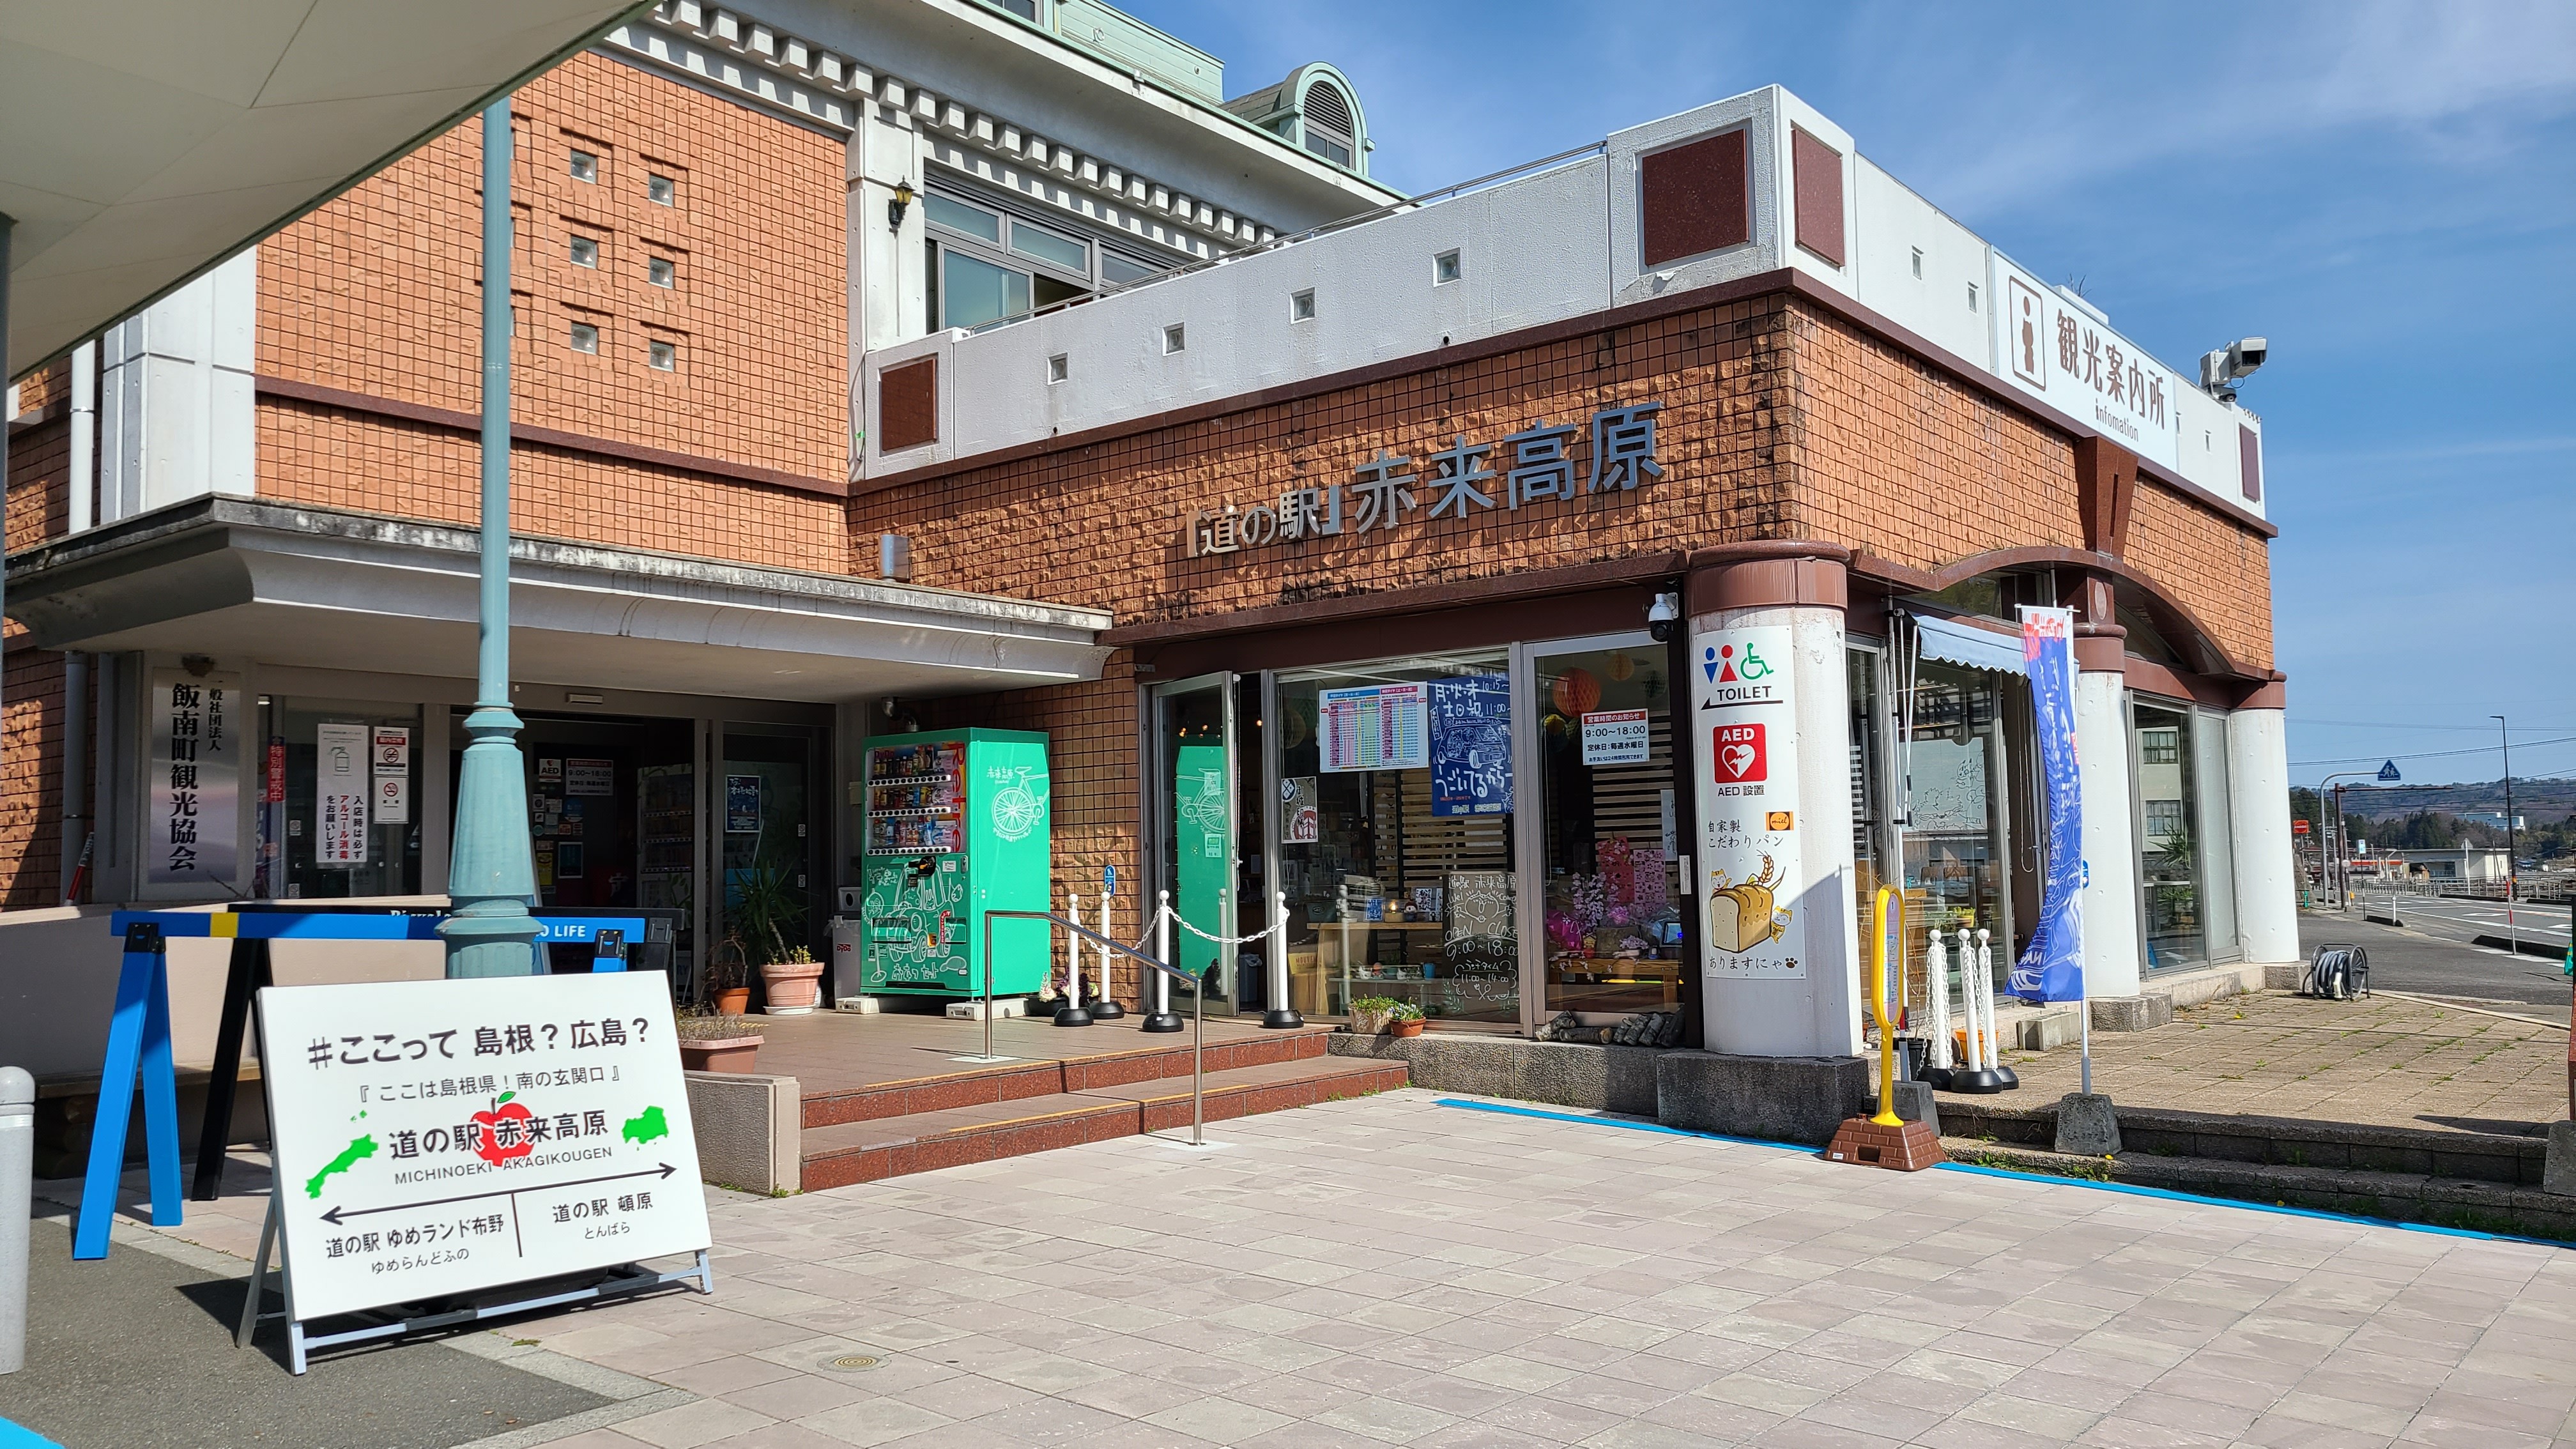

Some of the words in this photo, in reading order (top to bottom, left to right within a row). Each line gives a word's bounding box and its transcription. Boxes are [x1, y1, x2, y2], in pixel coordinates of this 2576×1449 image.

[2057, 309, 2165, 430] 観光案内所
[2096, 398, 2139, 442] infomation
[1352, 401, 1664, 534] 赤来高原
[1443, 700, 1483, 717] 土日祝
[1717, 686, 1772, 702] TOILET
[208, 680, 223, 751] 一般社団法人
[1588, 713, 1640, 723] 営業時間のお知らせ
[1721, 728, 1755, 742] AED
[169, 683, 201, 871] 飯南町観光協会
[271, 746, 282, 801] 特別警戒中
[1718, 786, 1740, 797] AED
[1743, 785, 1765, 796] 設置
[325, 795, 336, 859] をお願いします
[339, 795, 349, 860] アルコール消毒
[353, 795, 364, 859] 入店時は必ず
[1708, 819, 1742, 834] 自家製
[1708, 835, 1784, 849] こだわりパン
[1475, 875, 1517, 891] 赤来高原
[555, 926, 586, 937] LIFE
[1445, 920, 1473, 942] OPEN
[1488, 921, 1519, 938] CLOSE
[1710, 956, 1782, 970] ありますにゃ
[389, 1123, 483, 1160] 道の駅
[495, 1110, 609, 1147] 赤来高原
[394, 1160, 493, 1185] MICHINOEKI
[503, 1146, 613, 1172] AKAGIKOUGEN
[553, 1200, 609, 1223] 道の駅
[618, 1192, 654, 1214] 頓原
[326, 1232, 379, 1259] 道の駅
[388, 1215, 504, 1248] ゆめランド布野
[584, 1221, 631, 1240] とんばら
[371, 1247, 470, 1275] ゆめらんどふの
